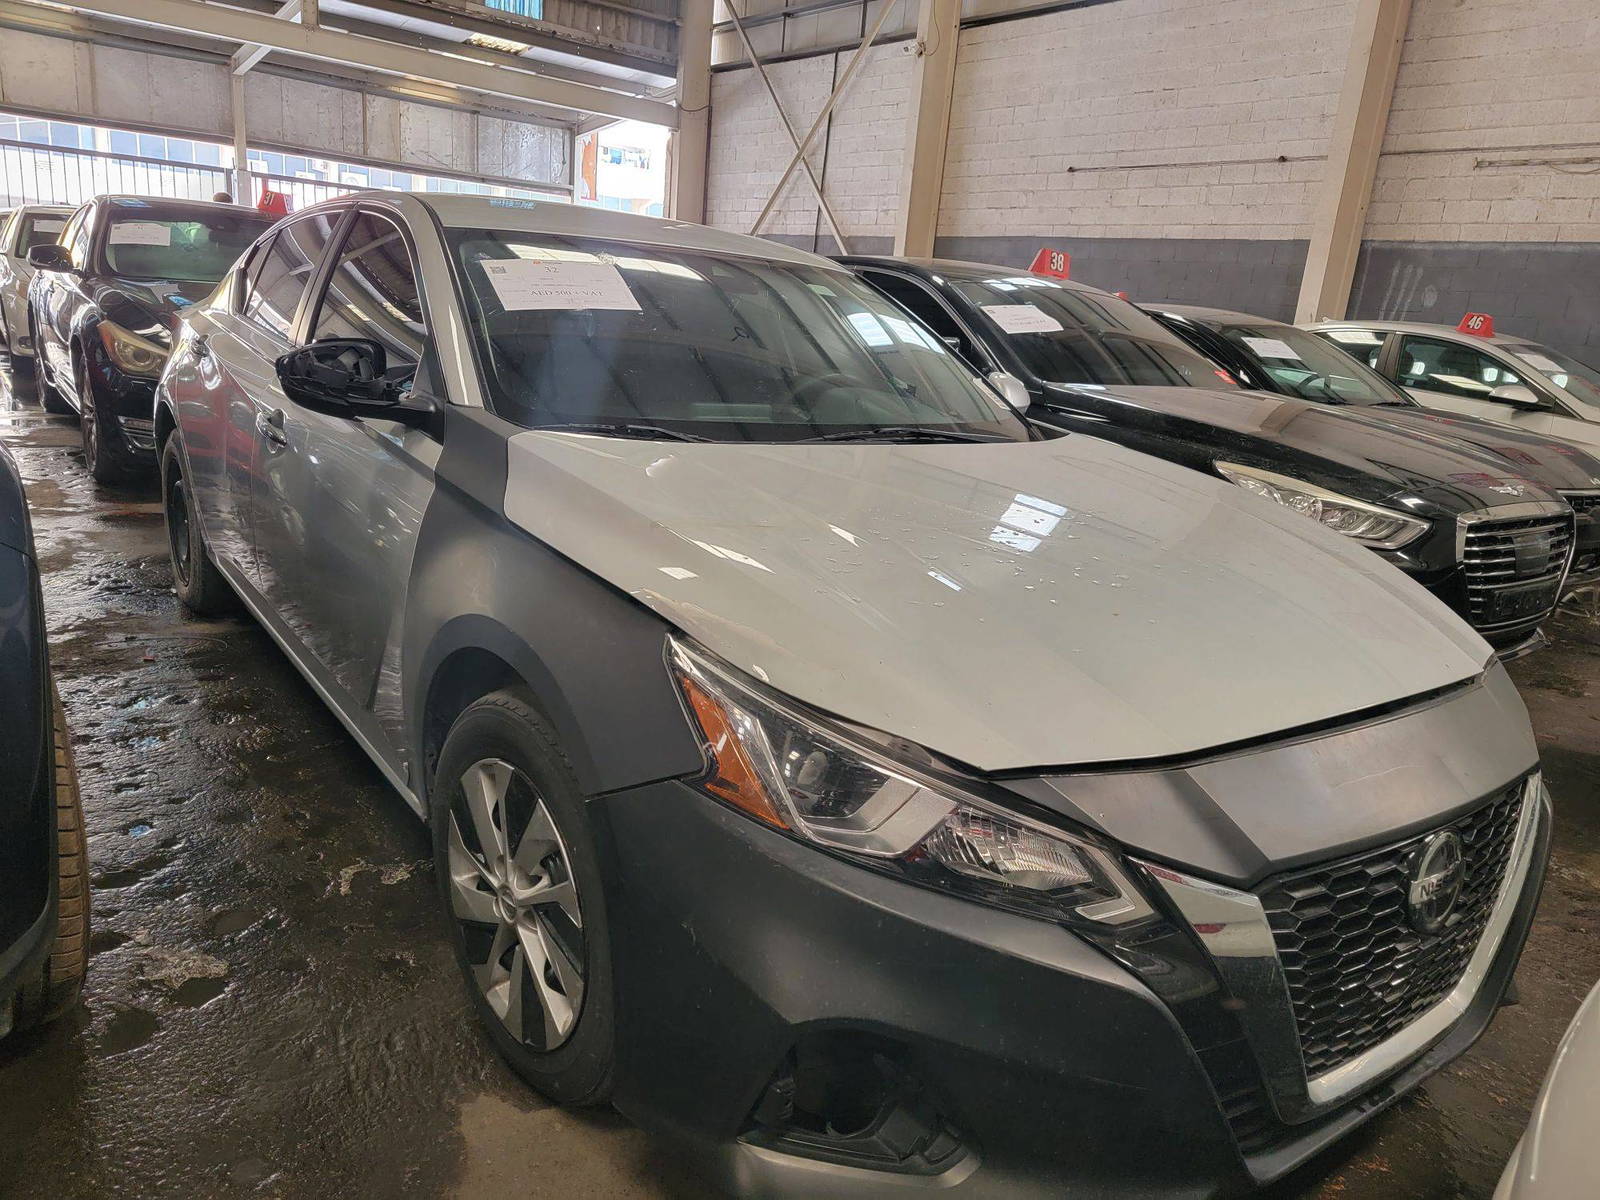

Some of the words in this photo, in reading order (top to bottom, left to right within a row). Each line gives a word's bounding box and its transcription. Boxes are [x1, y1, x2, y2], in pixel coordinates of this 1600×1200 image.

[263, 191, 275, 206] 31
[1050, 251, 1064, 272] 38
[530, 289, 554, 297] AED
[1468, 316, 1484, 330] 46
